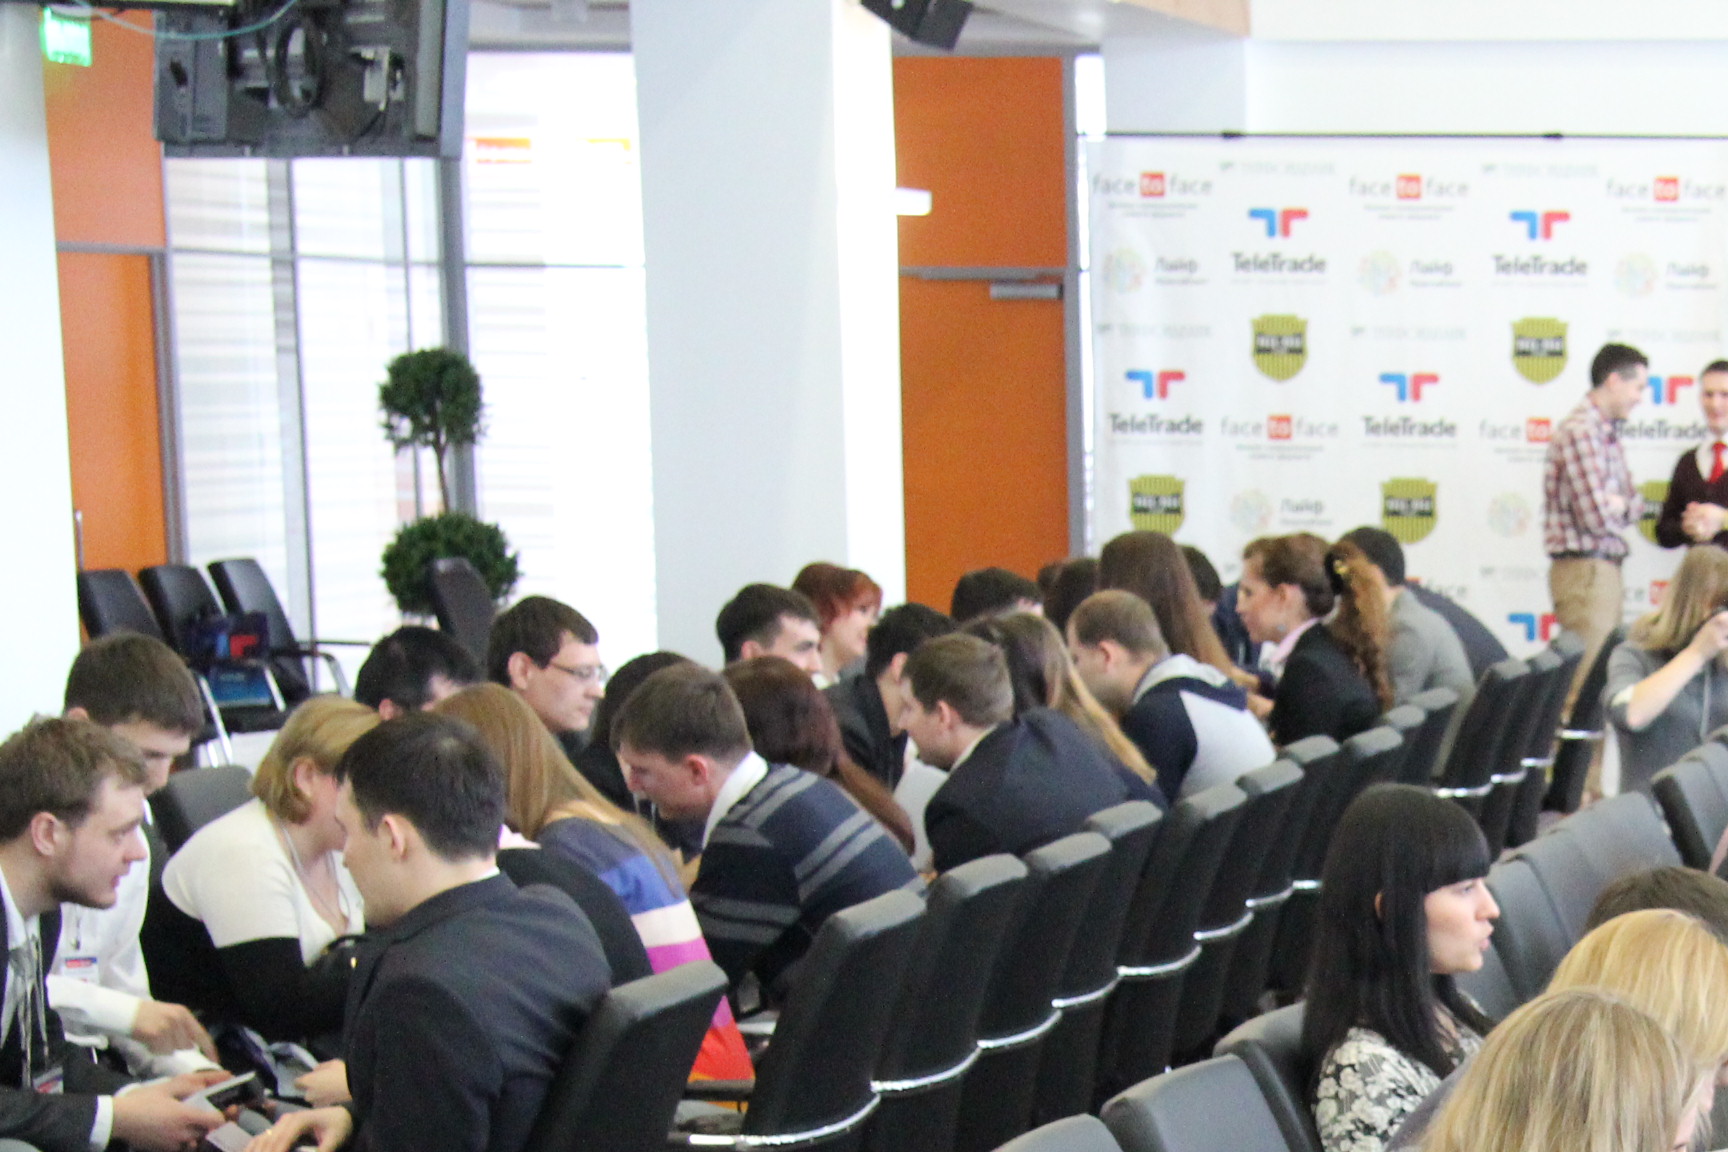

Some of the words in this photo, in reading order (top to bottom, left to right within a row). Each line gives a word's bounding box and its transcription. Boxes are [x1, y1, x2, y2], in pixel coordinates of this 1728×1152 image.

[1093, 172, 1136, 196] face
[1169, 173, 1213, 195] face
[1348, 175, 1391, 197] face
[1425, 176, 1470, 197] face
[1605, 177, 1649, 198] face
[1682, 180, 1726, 200] face
[1232, 251, 1326, 273] TeleTrade
[1493, 254, 1588, 276] TeleTrade
[1107, 412, 1204, 435] TeleTrade
[1220, 416, 1263, 438] face
[1295, 416, 1339, 438] face
[1362, 415, 1457, 437] TeleTrade
[1479, 418, 1522, 441] face
